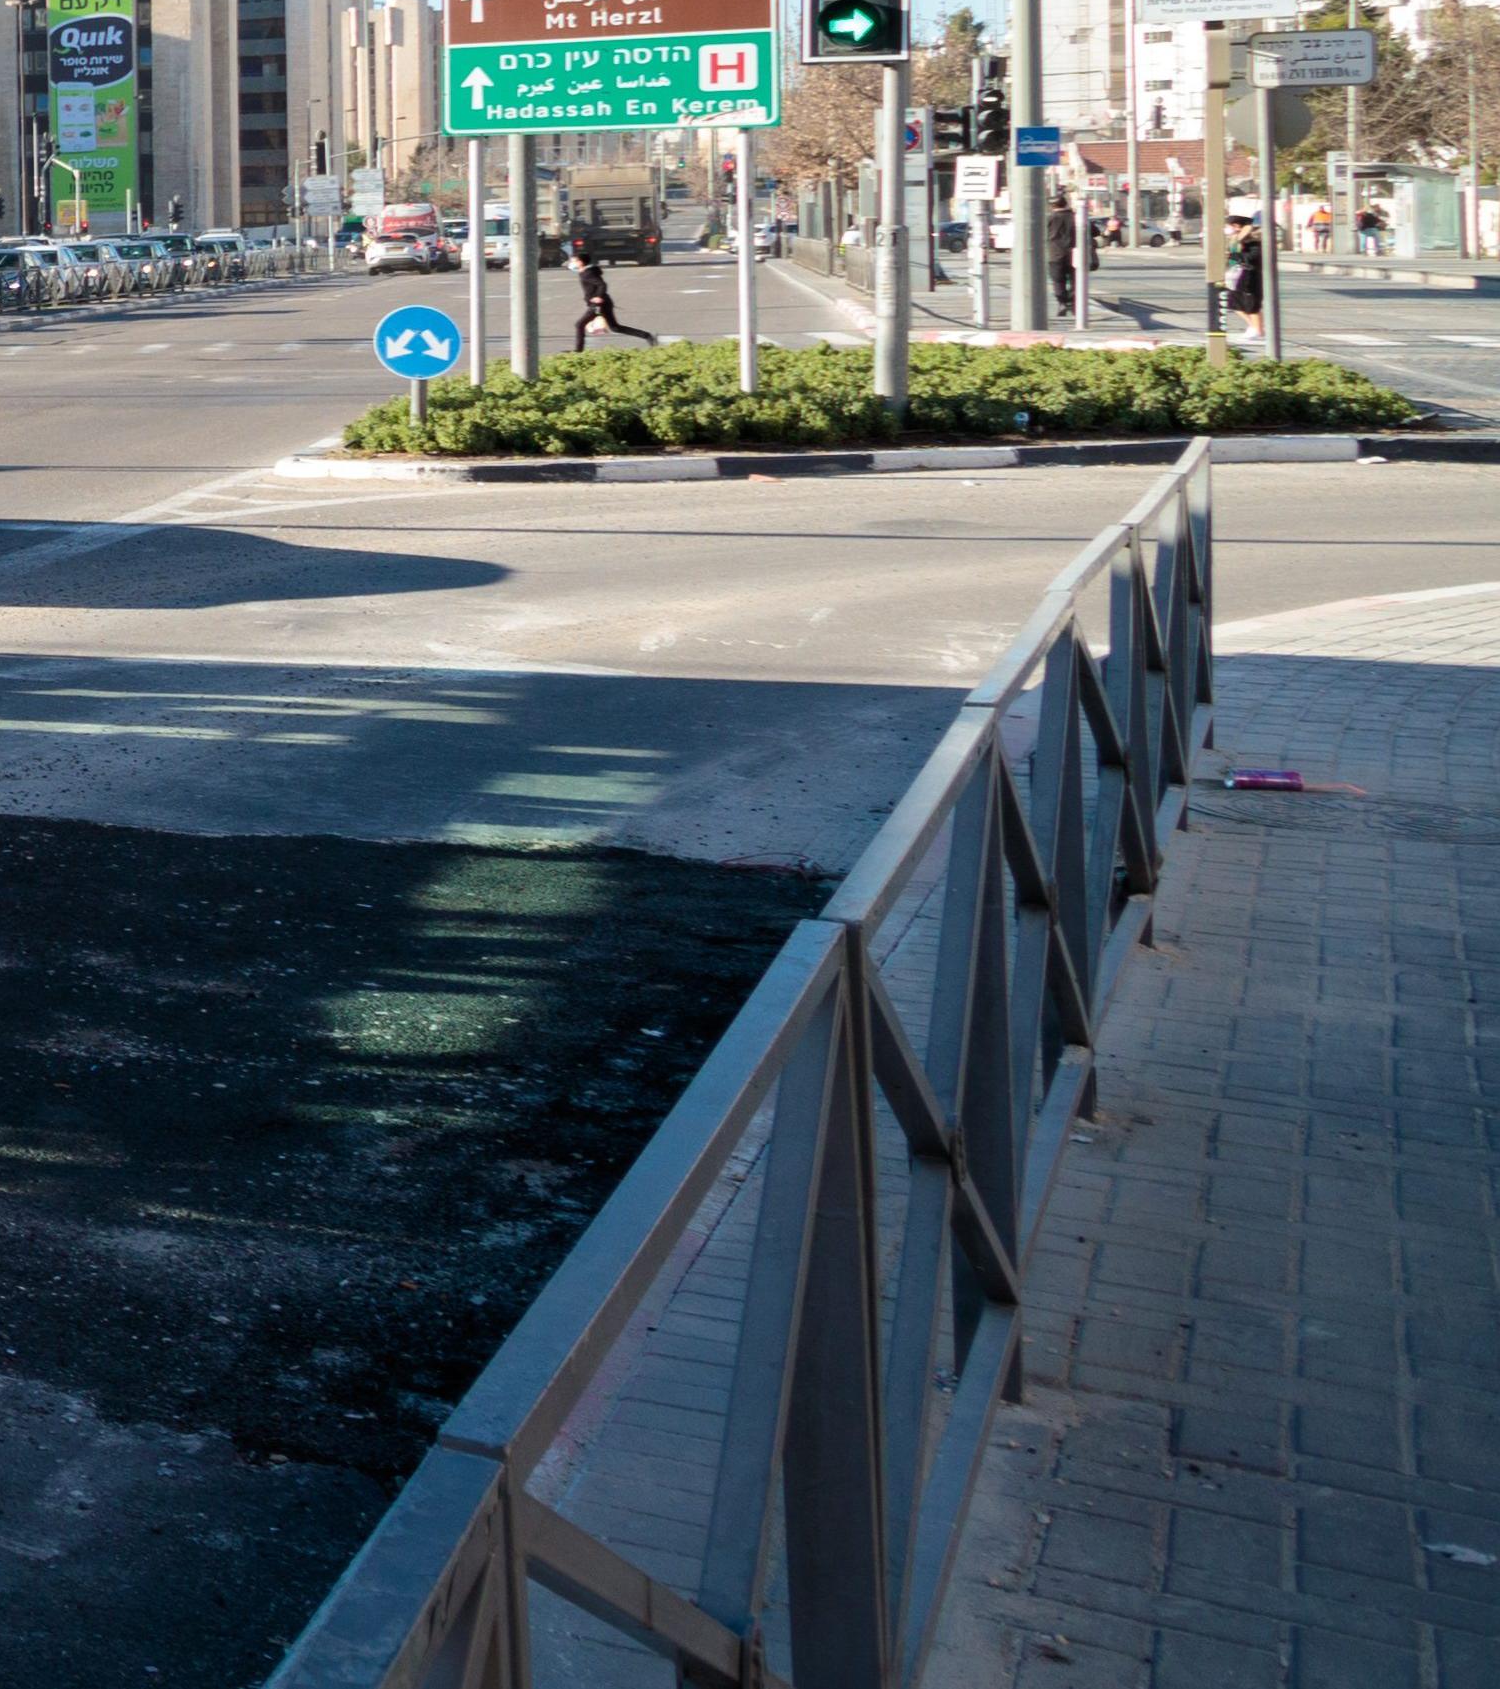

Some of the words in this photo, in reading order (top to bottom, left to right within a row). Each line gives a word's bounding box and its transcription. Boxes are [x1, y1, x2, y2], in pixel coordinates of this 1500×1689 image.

[545, 12, 578, 30] Mt
[590, 7, 664, 28] Herzl
[59, 25, 124, 55] Quik
[59, 56, 89, 67] סופר
[89, 55, 124, 66] שירות
[499, 52, 552, 70] כרם
[564, 49, 600, 71] עין
[612, 45, 691, 65] הדסה
[709, 52, 745, 84] H
[516, 78, 555, 97] كيرم
[566, 78, 603, 95] عين
[486, 100, 612, 120] Hadassah
[626, 99, 657, 116] En
[671, 97, 759, 115] Kerem
